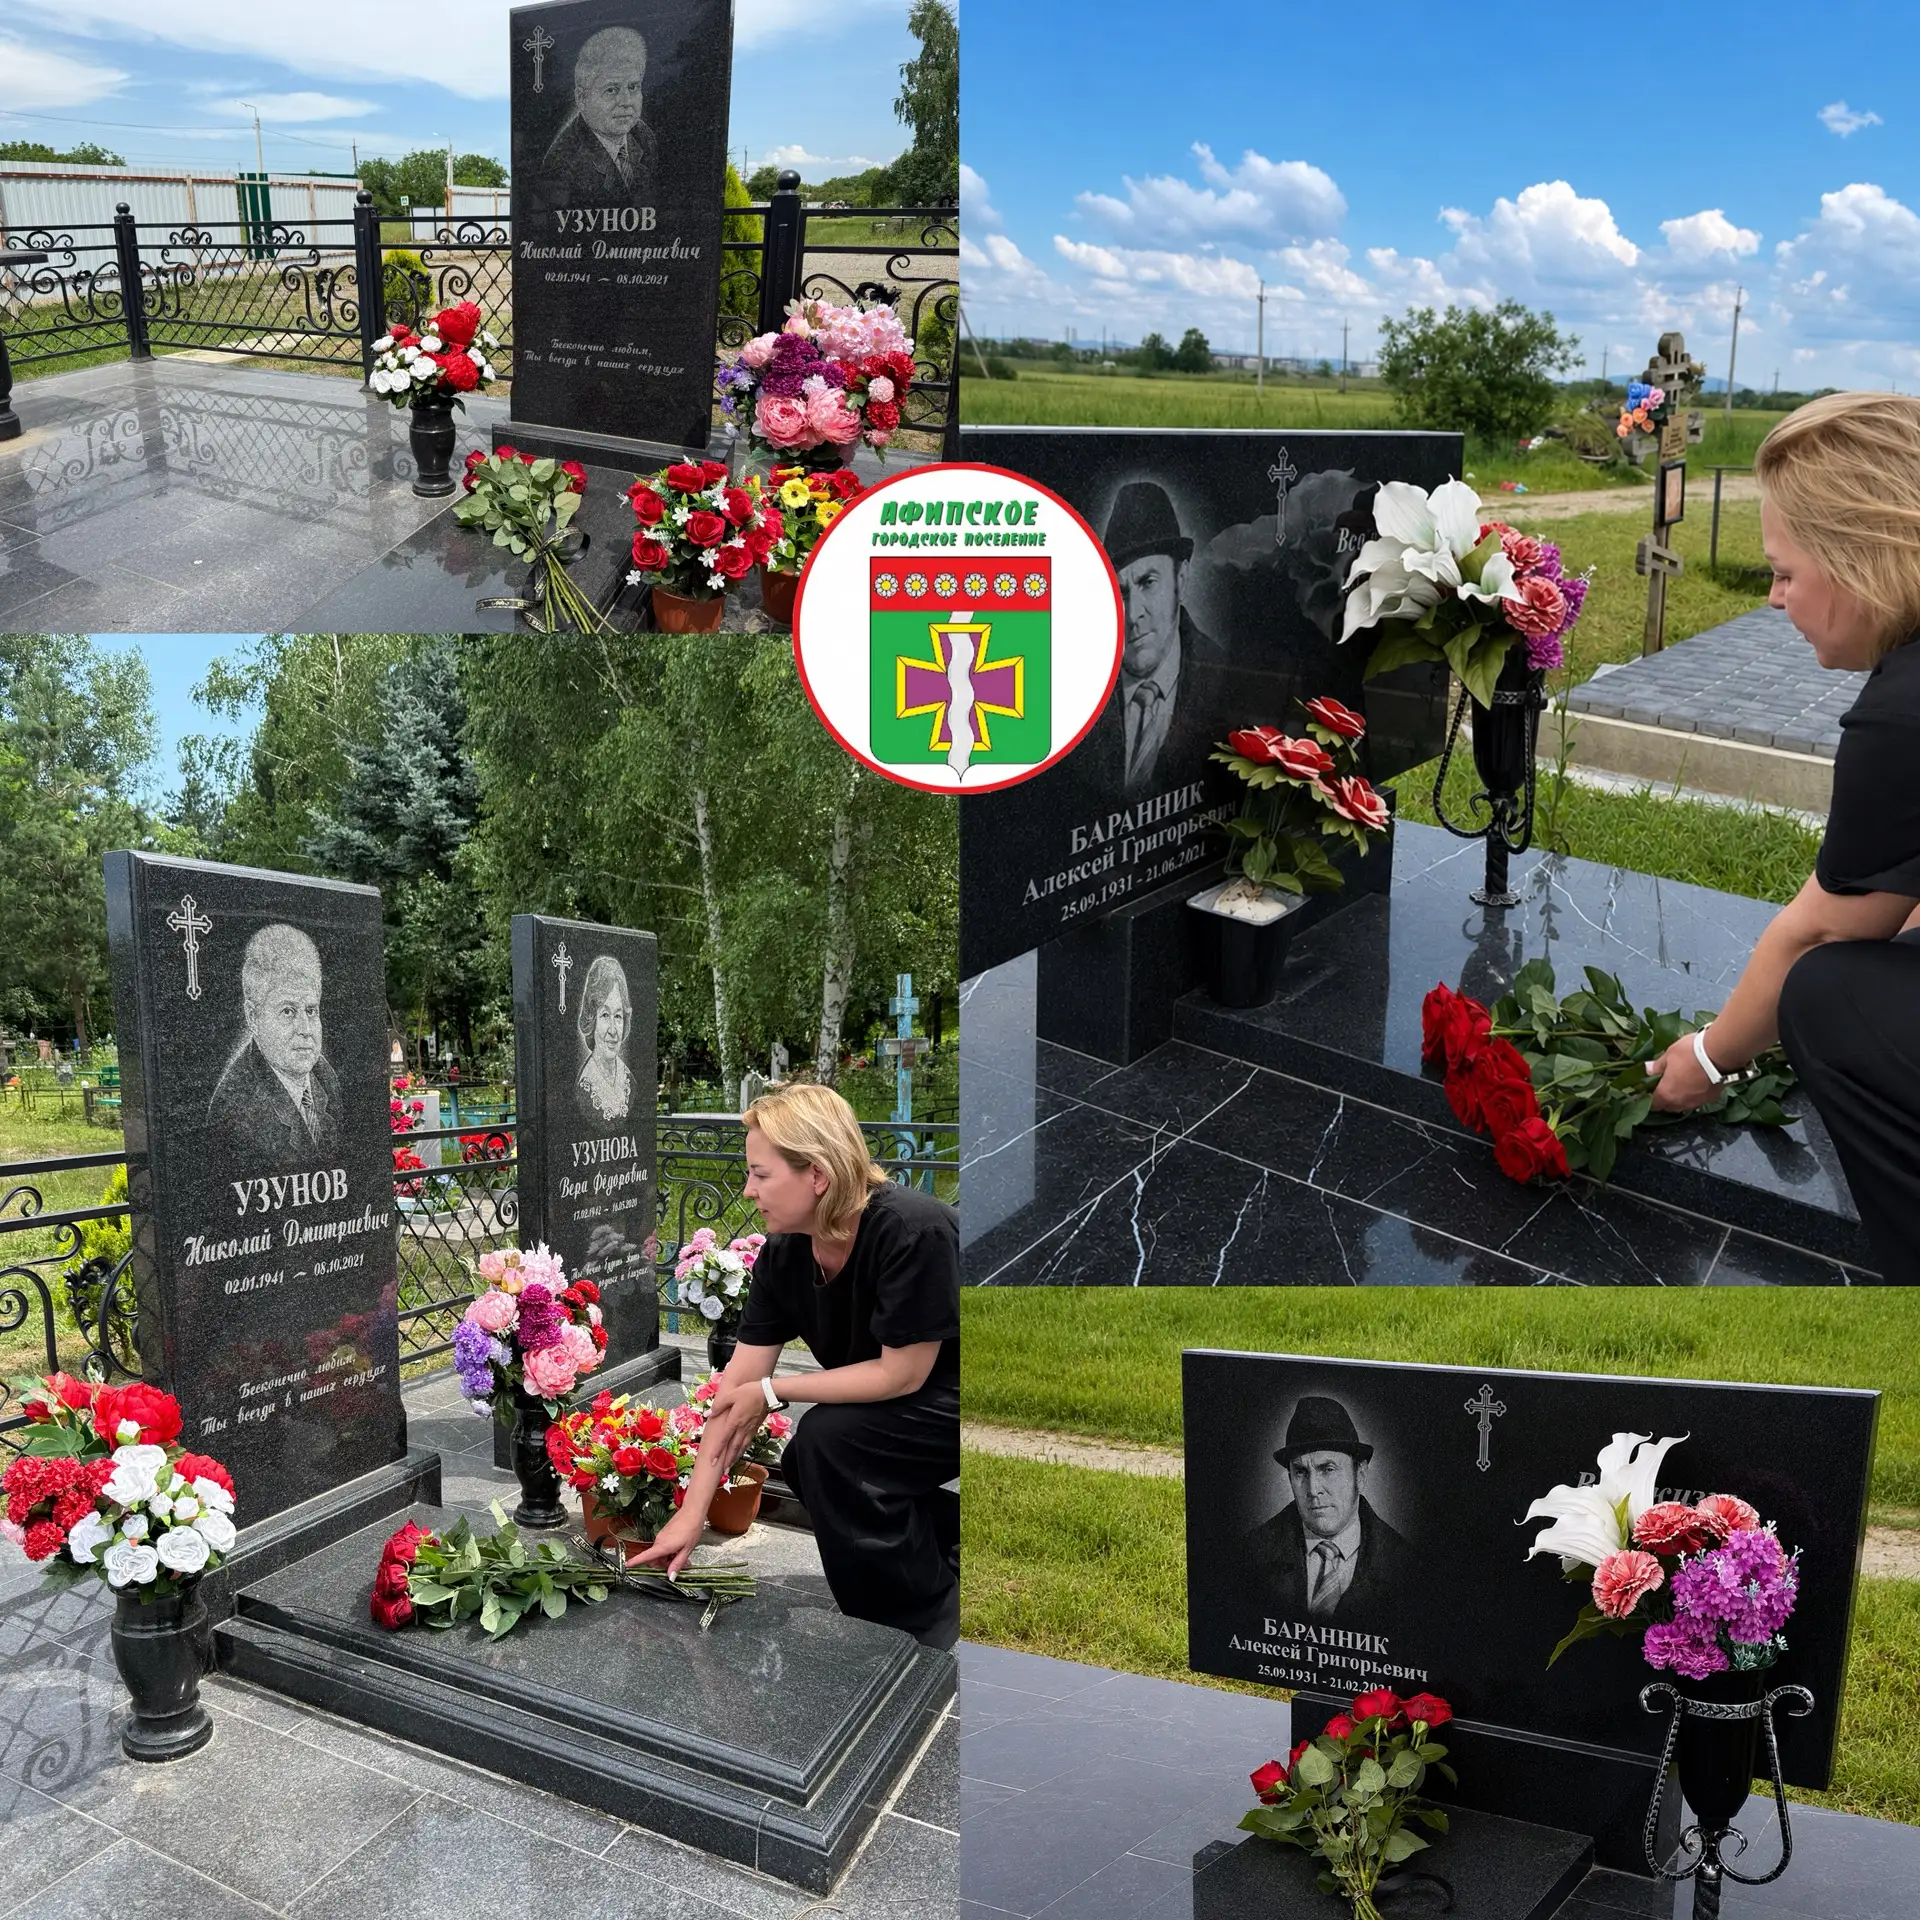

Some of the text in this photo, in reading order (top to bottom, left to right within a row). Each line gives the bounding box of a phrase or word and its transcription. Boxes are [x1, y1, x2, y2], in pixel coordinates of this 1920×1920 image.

[555, 207, 656, 232] УЗУНОВ
[520, 237, 701, 263] Николай Дмитриевич
[545, 272, 591, 283] 02.01.1941
[616, 275, 668, 285] 08.10.2021
[525, 351, 685, 376] Ты всегда в наших сердцах
[551, 339, 652, 355] Бесконечно любим,
[1069, 780, 1204, 855] БАРАННИК
[1022, 846, 1115, 906] Алексей
[1061, 873, 1133, 922] 25.09.1931
[572, 1136, 638, 1167] УЗУНОВА
[231, 1168, 348, 1216] УЗУНОВ
[560, 1163, 648, 1200] Вера Фёдоровна
[184, 1203, 390, 1267] Николай Дмитриевич
[225, 1269, 285, 1295] 02.01.1941
[314, 1252, 365, 1276] 08.10.2021
[200, 1364, 386, 1437] Ты всегда в наших сердцах
[239, 1367, 307, 1399] Бесконечно
[1263, 1617, 1389, 1655] БАРАННИК
[1228, 1634, 1428, 1683] Алексей Григорьевич
[1257, 1664, 1318, 1684] 25.09.1931
